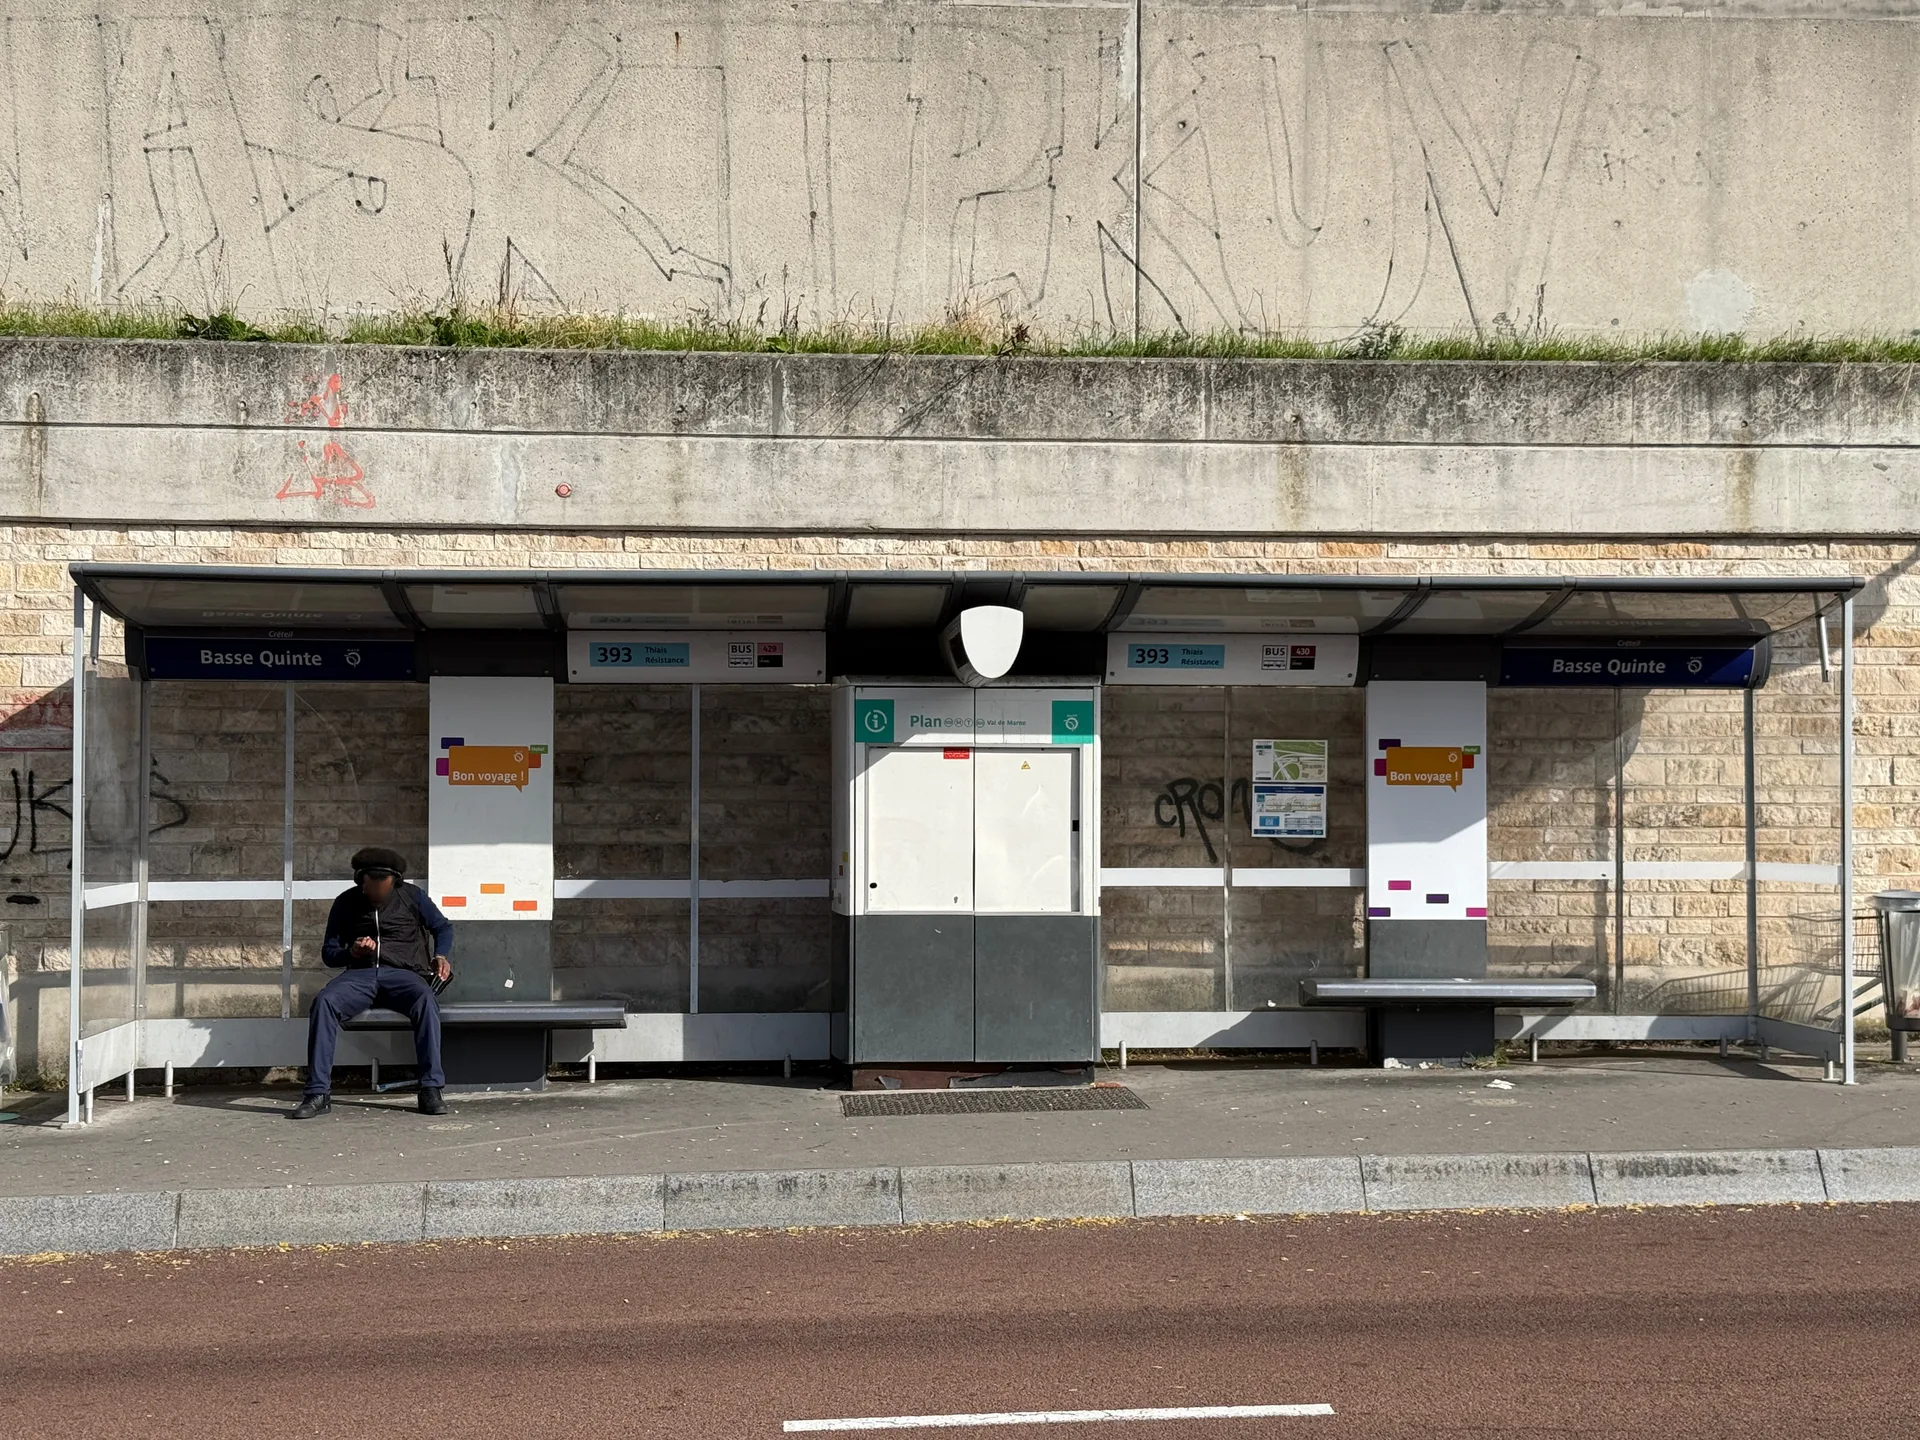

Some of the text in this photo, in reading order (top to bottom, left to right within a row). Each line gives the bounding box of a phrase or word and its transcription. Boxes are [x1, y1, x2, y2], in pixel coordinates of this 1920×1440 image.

[268, 630, 293, 638] Créteil
[1617, 639, 1640, 647] Créteil
[645, 646, 667, 654] Thiais
[731, 645, 752, 653] BUS
[1181, 648, 1203, 656] Thiais
[1265, 647, 1285, 656] BUS
[1296, 647, 1310, 655] 430
[201, 649, 322, 668] Basse Quinte
[597, 647, 632, 663] 393
[1135, 648, 1169, 664] 393
[645, 656, 684, 664] Résistance
[1181, 658, 1219, 666] Résistance
[1553, 659, 1666, 675] Basse Quinte
[909, 715, 942, 728] Plan
[452, 771, 474, 781] Bon
[477, 772, 518, 783] voyage
[1390, 771, 1411, 781] Bon
[1414, 772, 1452, 783] voyage
